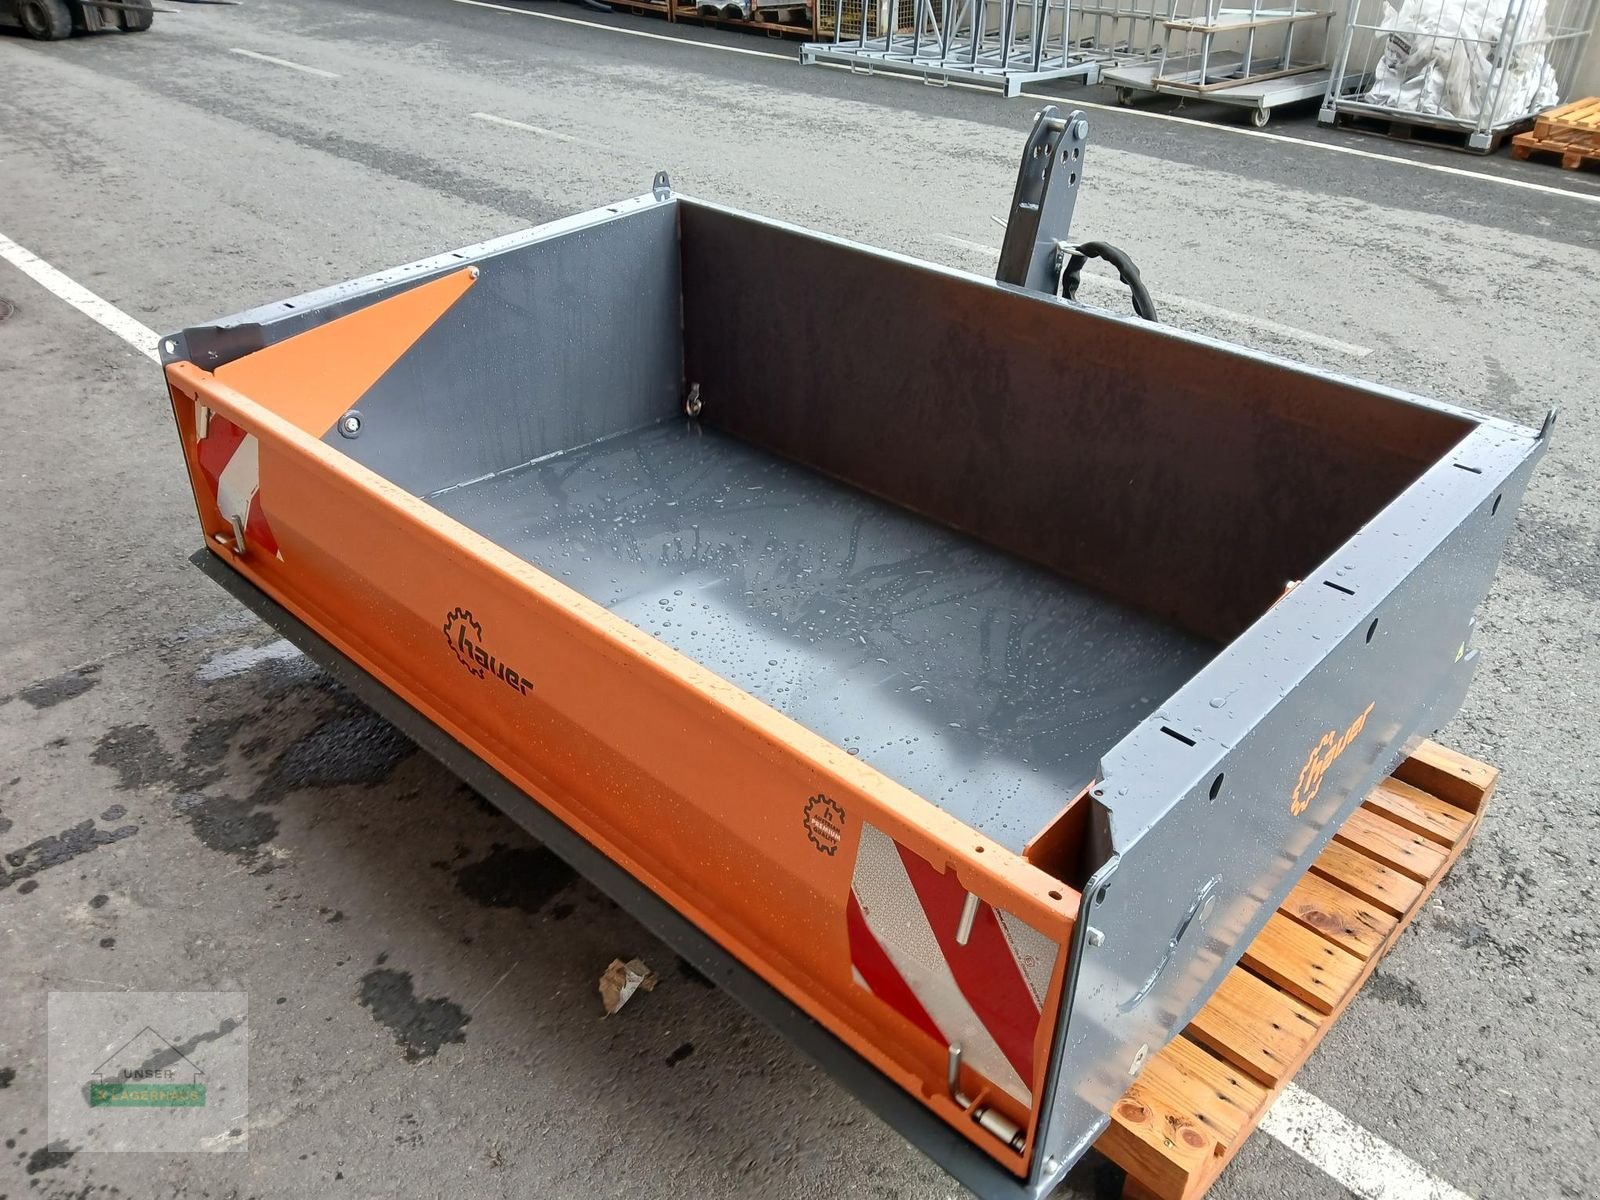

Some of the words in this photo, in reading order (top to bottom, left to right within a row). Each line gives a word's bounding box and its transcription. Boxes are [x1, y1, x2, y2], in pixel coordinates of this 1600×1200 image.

[458, 623, 534, 697] hauer
[1303, 700, 1376, 794] hauer
[811, 818, 841, 842] PREMIUM
